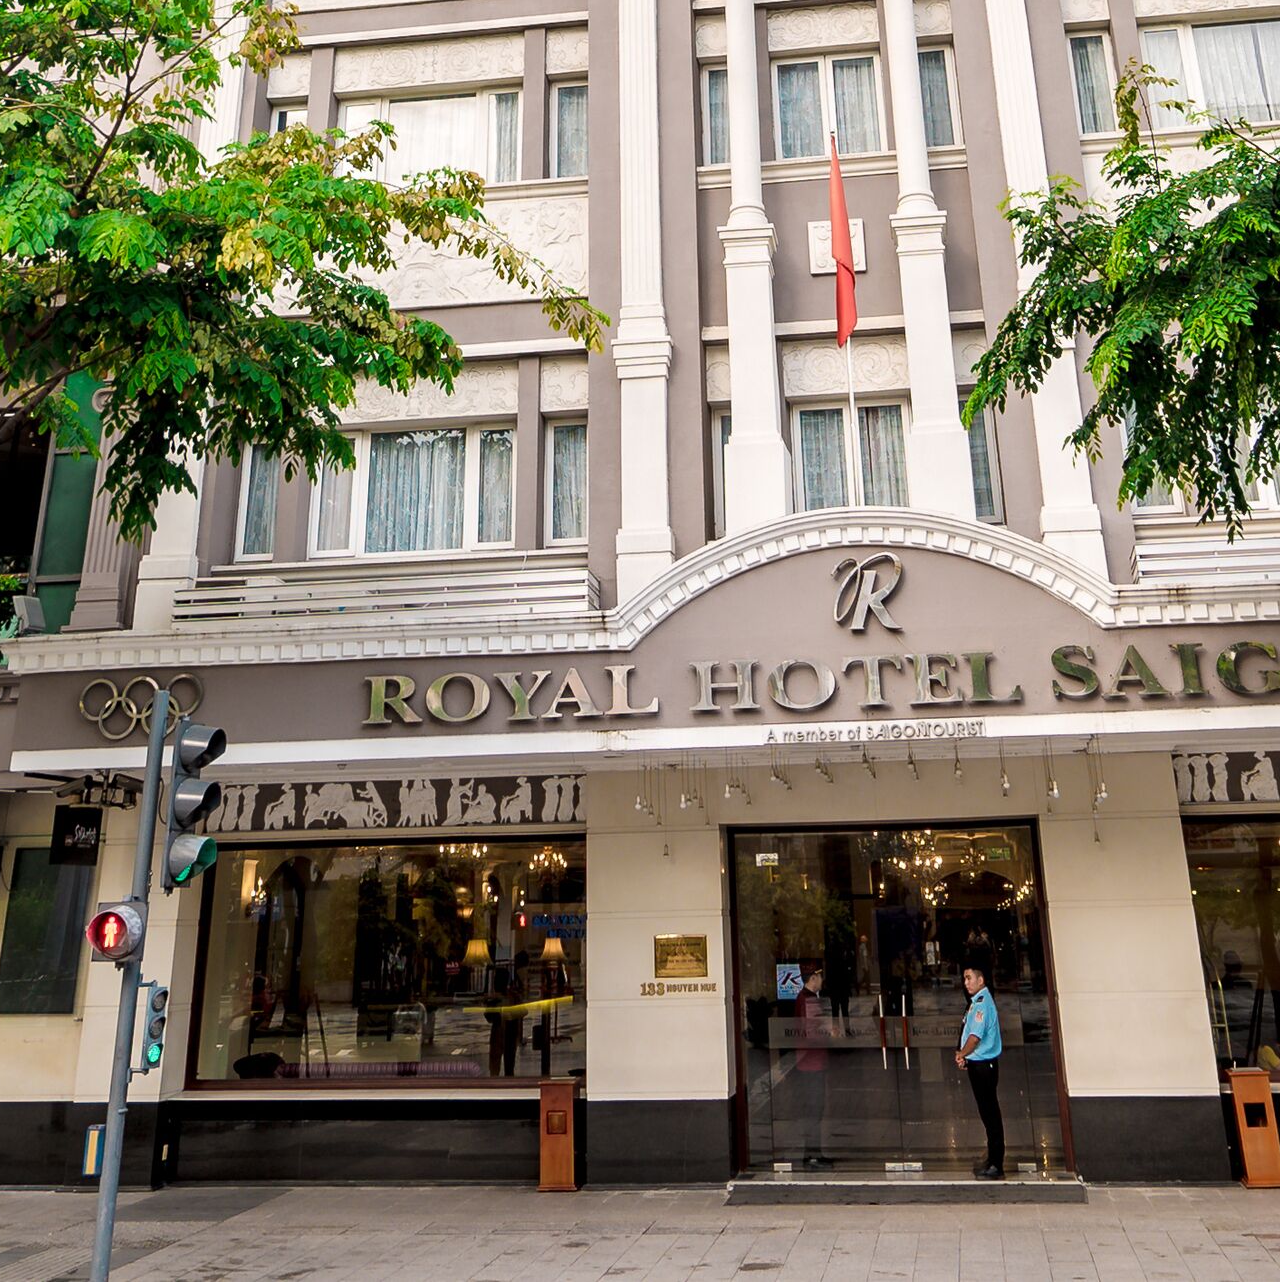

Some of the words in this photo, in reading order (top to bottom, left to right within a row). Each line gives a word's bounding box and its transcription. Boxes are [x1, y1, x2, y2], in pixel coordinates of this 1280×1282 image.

[363, 663, 661, 725] ROYAL
[688, 651, 1024, 714] HOTEL
[766, 727, 778, 743] A
[782, 727, 843, 743] member
[847, 725, 862, 741] of
[866, 720, 986, 739] SAIGONTOURIST
